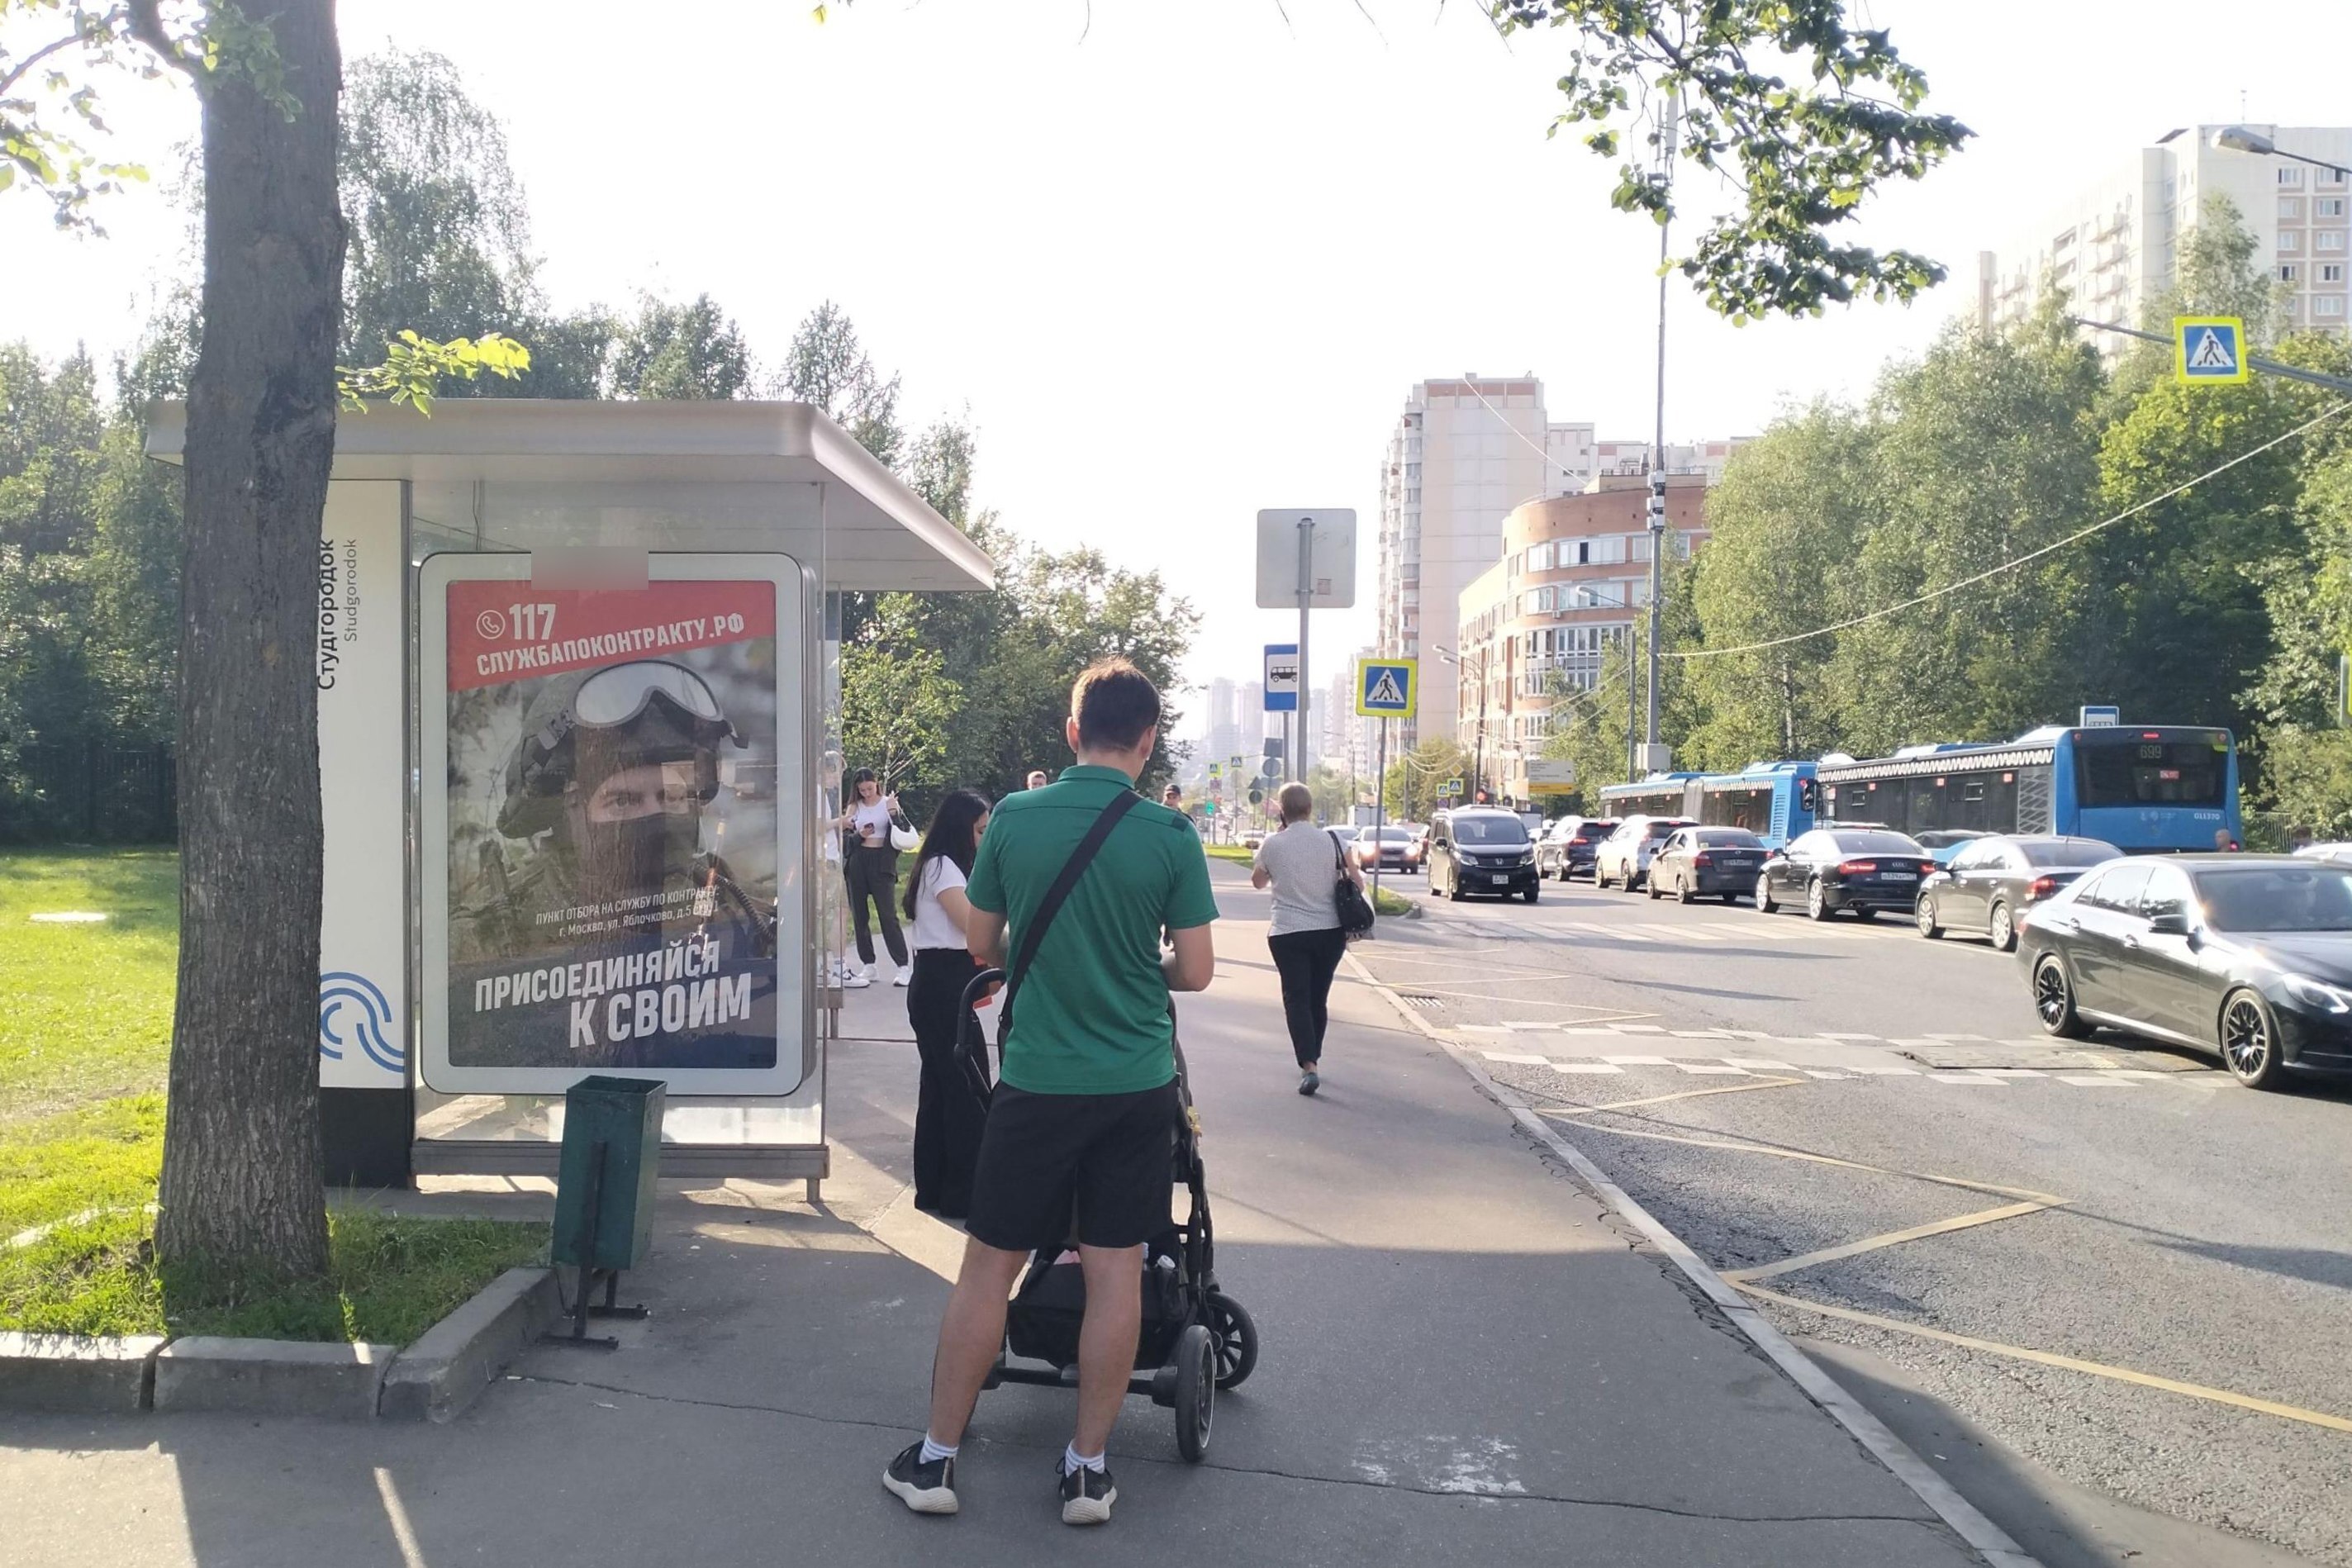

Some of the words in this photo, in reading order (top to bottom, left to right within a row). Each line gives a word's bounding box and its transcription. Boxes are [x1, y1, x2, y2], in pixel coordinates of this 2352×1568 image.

[317, 539, 340, 690] Студгородок
[343, 539, 360, 642] Studgorodok
[508, 603, 557, 640] 117
[476, 613, 745, 676] СЛУЖБАПОКОНТРАКТУ.РФ
[2140, 744, 2162, 759] 699
[536, 910, 564, 925] ПУНКТ
[567, 905, 600, 920] ОТБОРА
[601, 902, 613, 915] НА
[615, 895, 652, 912] СЛУЖБУ
[653, 893, 665, 906] ПО
[559, 928, 566, 938] г.
[608, 919, 621, 932] ул.
[623, 910, 676, 927] Яблочкова,
[475, 940, 720, 1012] ПРИСОЕДИНЯЙСЯ
[570, 998, 596, 1048] К
[607, 972, 752, 1042] СВОИМ
